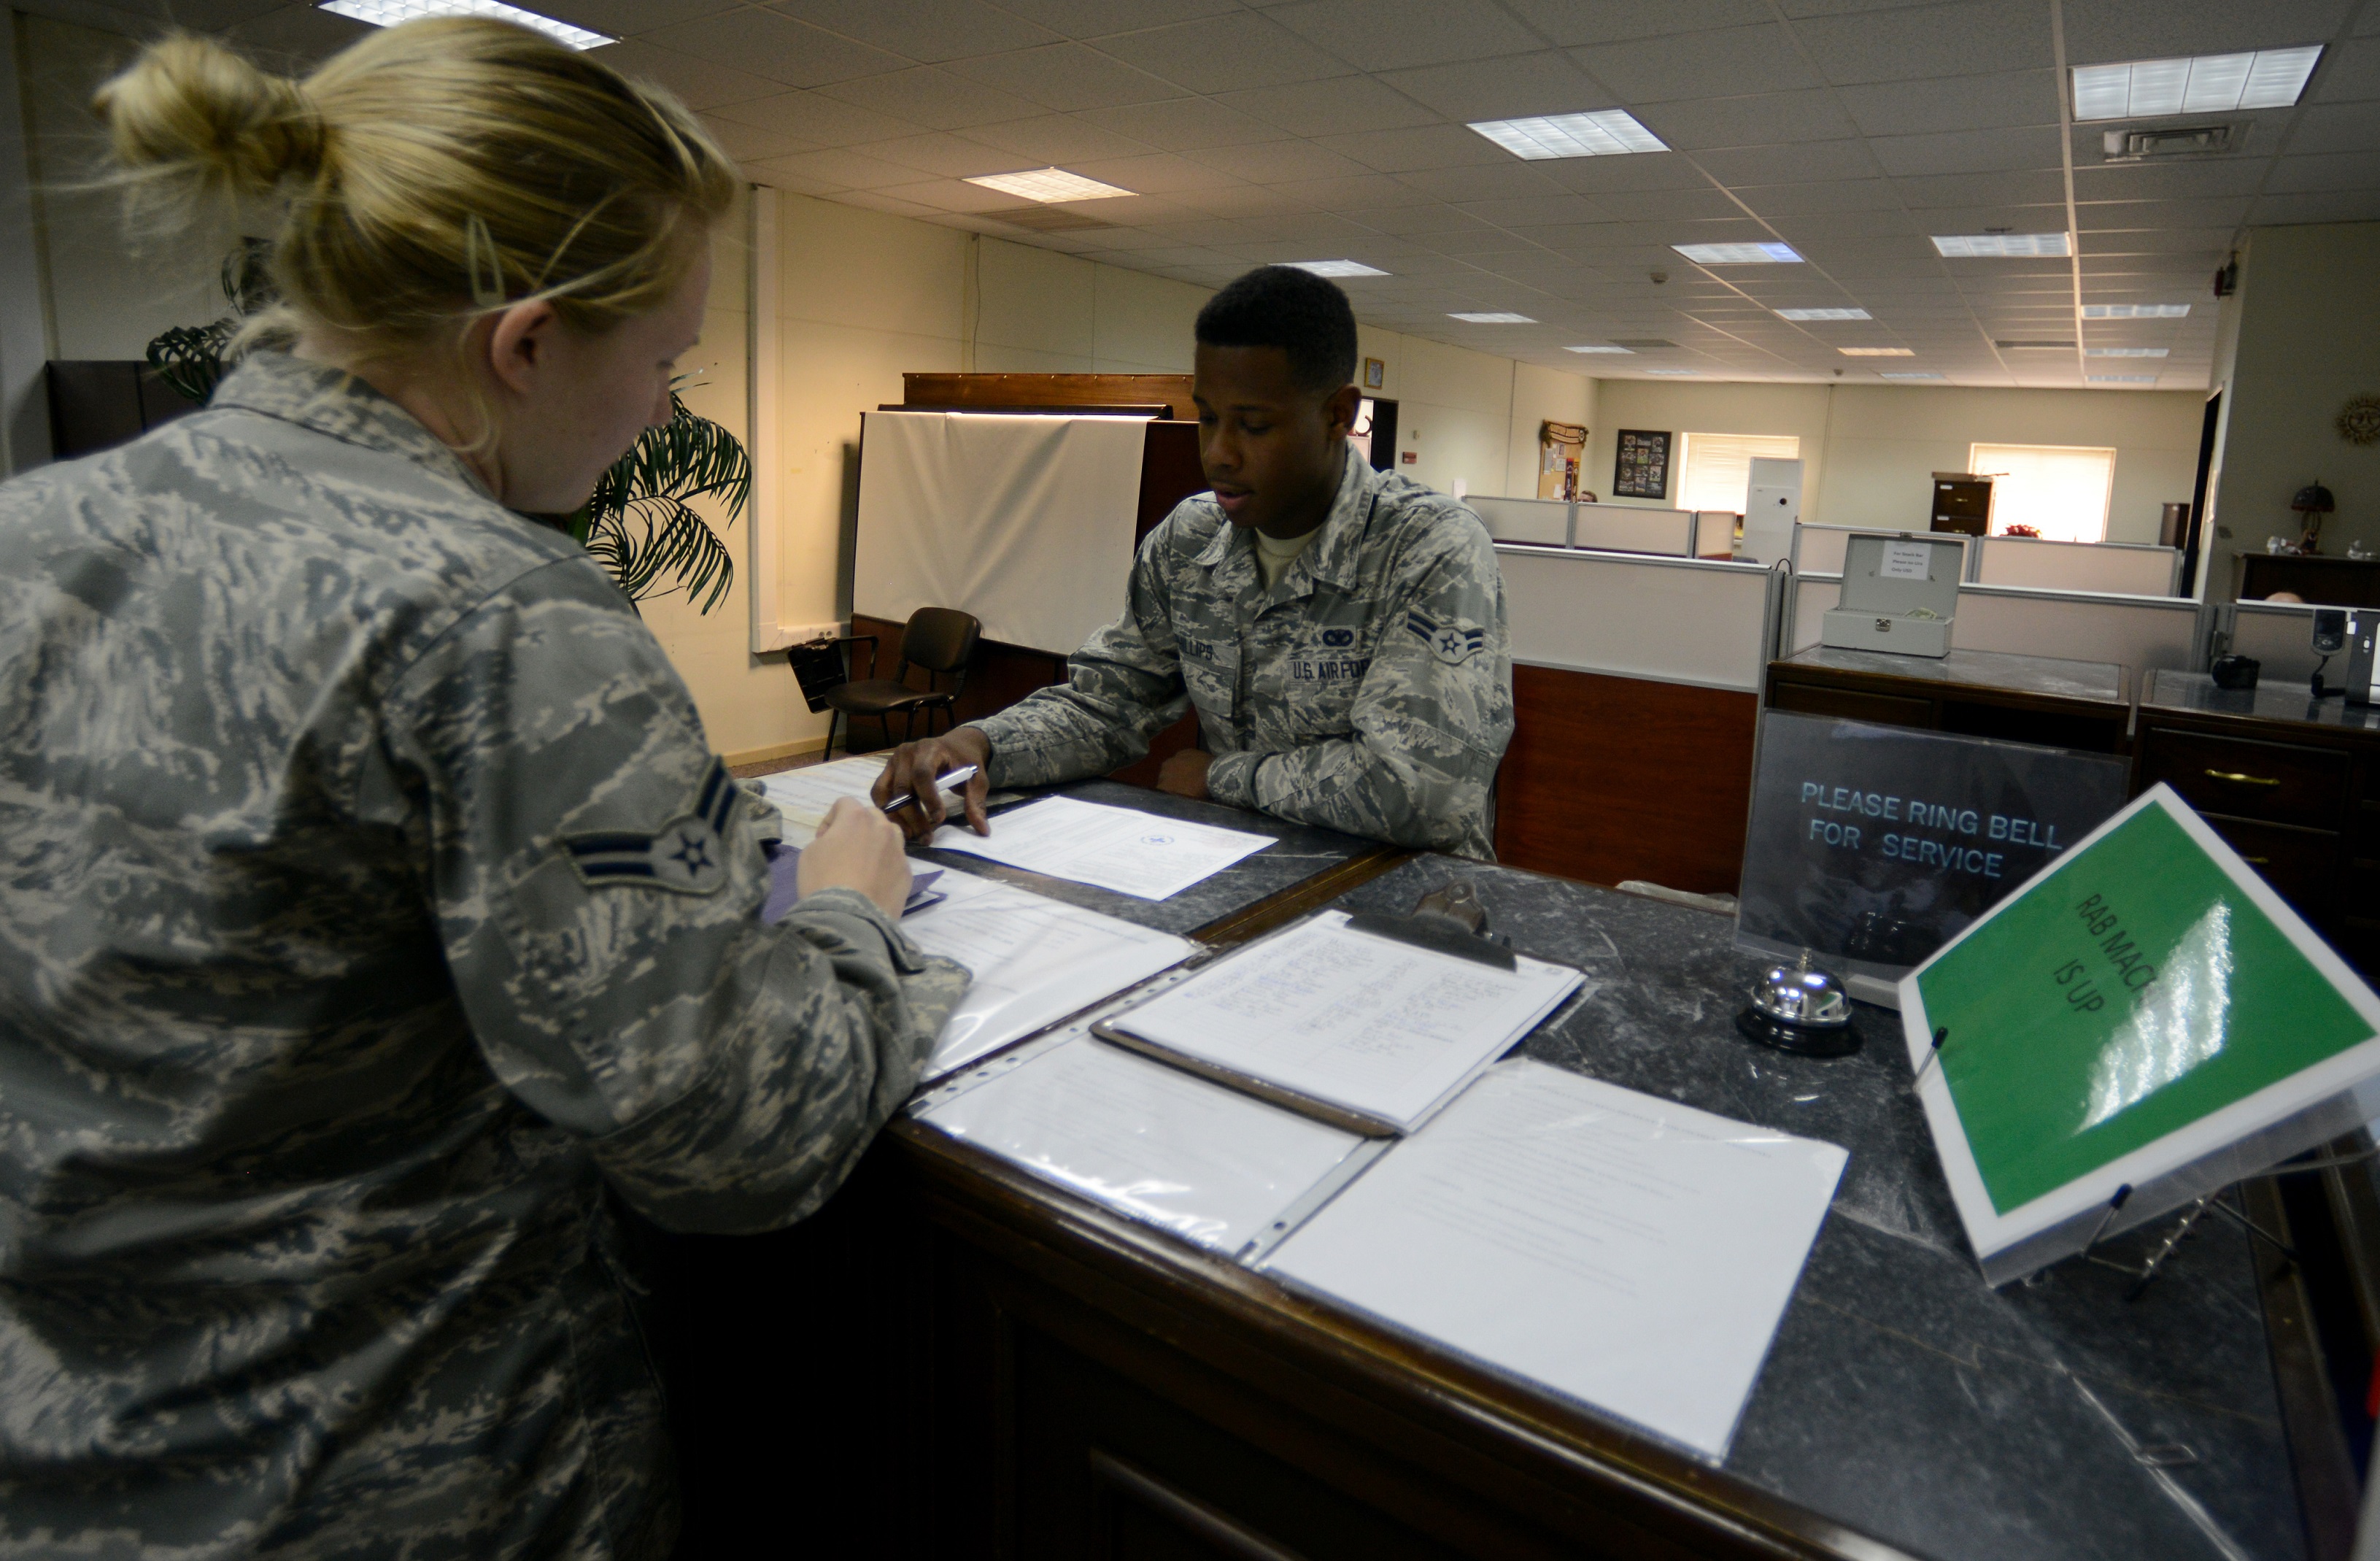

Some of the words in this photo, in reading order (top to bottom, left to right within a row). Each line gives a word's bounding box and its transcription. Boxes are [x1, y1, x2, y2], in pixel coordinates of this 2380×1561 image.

[1294, 660, 1315, 679] U.S.
[1318, 660, 1340, 679] AIR
[1340, 658, 1371, 679] FOR
[1801, 782, 1901, 821] PLEASE
[1908, 800, 1979, 836] RING
[1988, 814, 2063, 850] BELL
[1809, 819, 1861, 849] FOR
[1881, 833, 2004, 878] SERVICE
[2076, 893, 2118, 936] RAB
[2053, 958, 2085, 985] IS
[2066, 979, 2105, 1013] UP
